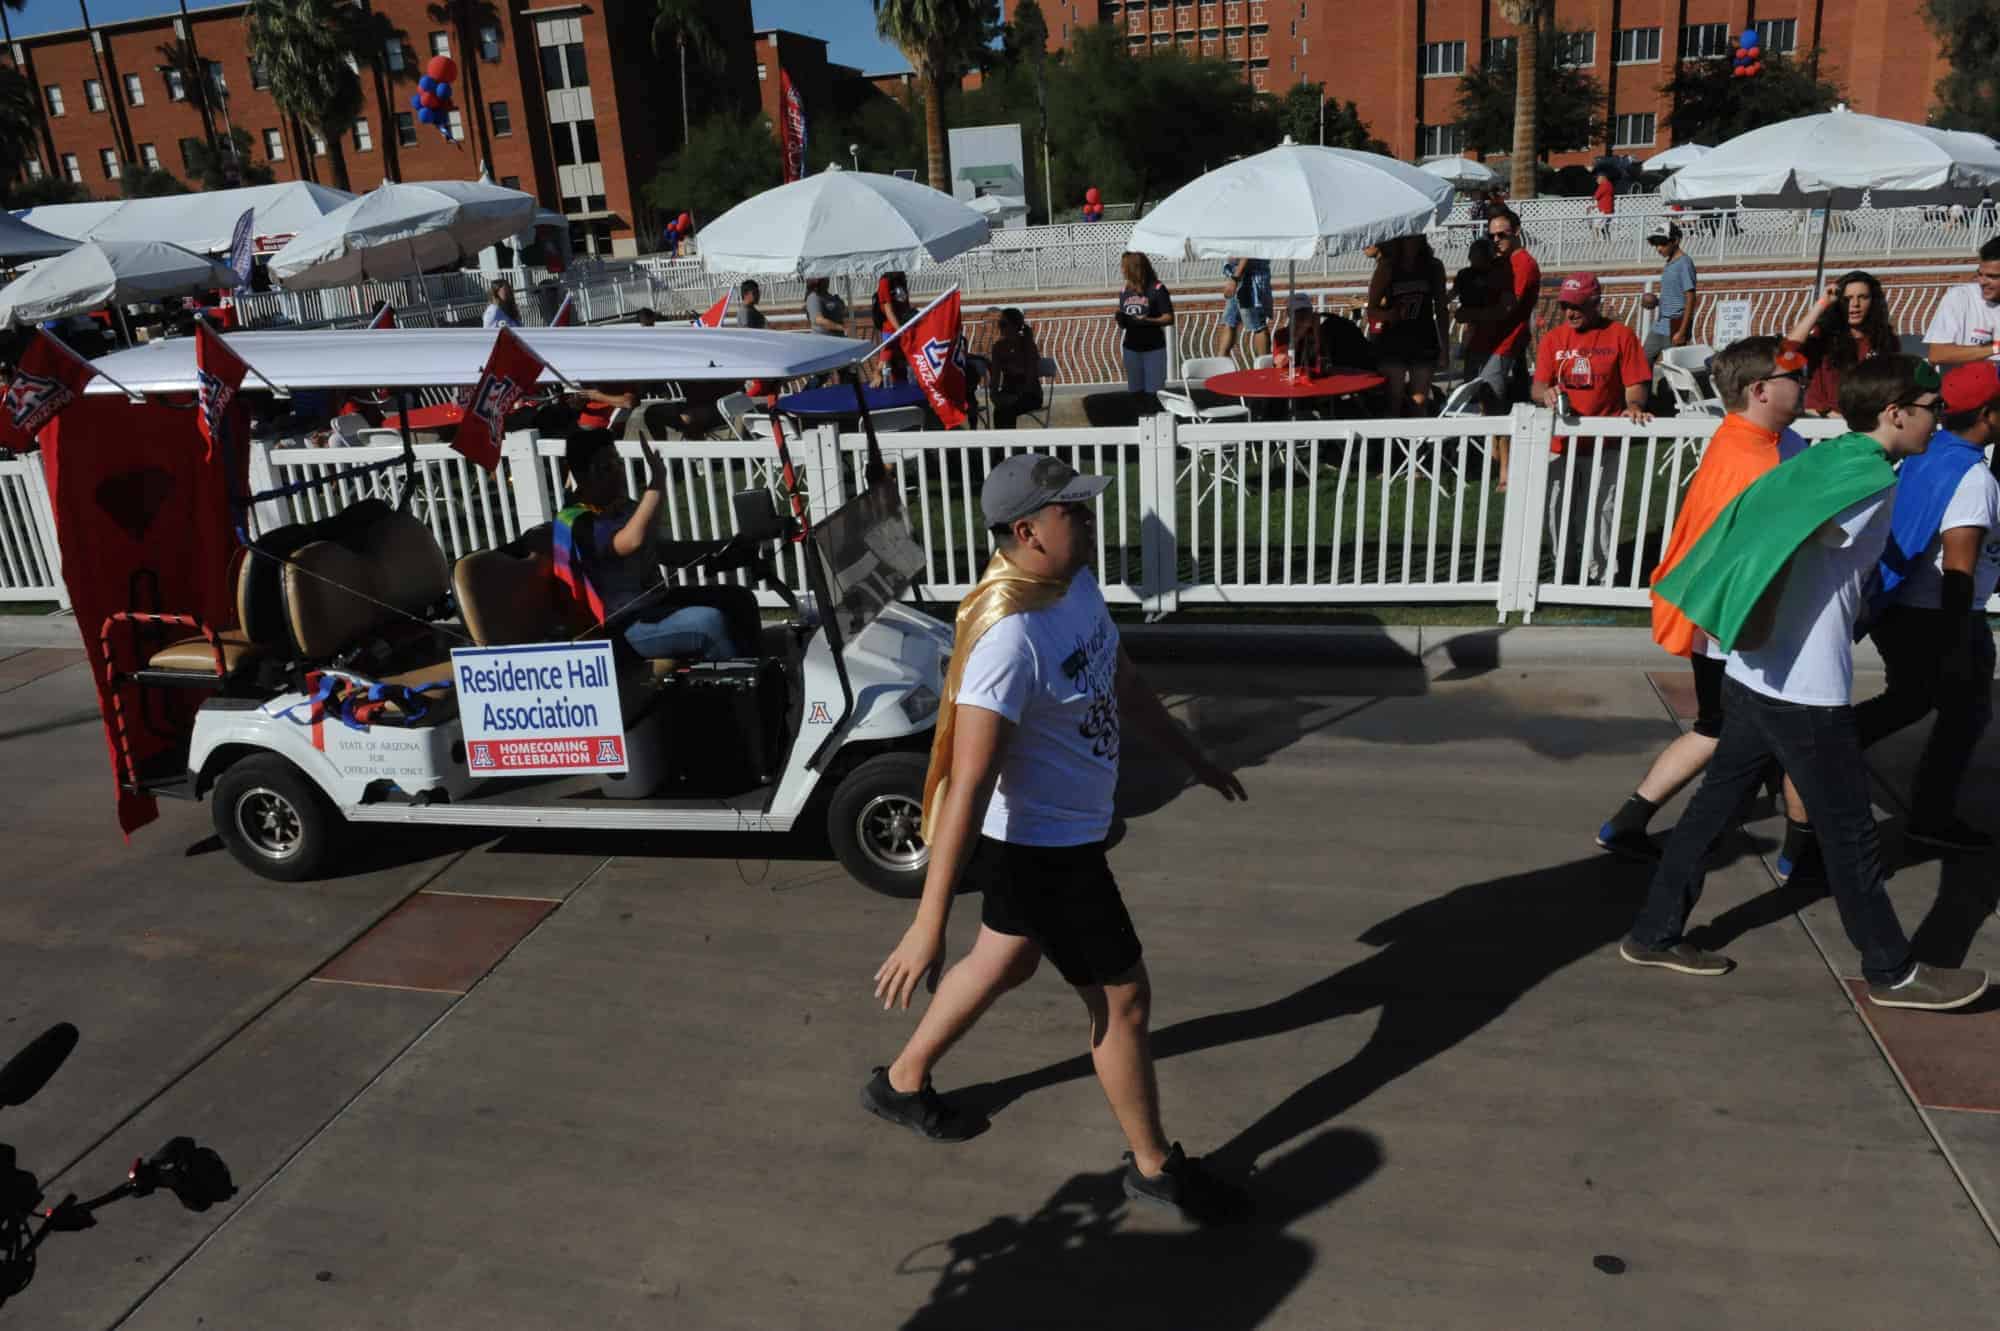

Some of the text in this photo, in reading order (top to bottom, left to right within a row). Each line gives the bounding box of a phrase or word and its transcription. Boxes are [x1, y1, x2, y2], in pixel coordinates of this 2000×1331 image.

[459, 655, 609, 694] Residence Hall
[482, 695, 598, 731] Association
[340, 741, 420, 751] STATE OF ARIZONA
[500, 740, 589, 754] HOMECOMING
[369, 754, 385, 762] FOR
[502, 751, 590, 766] CELEBRATION
[343, 766, 378, 775] OFFICIAL
[400, 767, 424, 776] ONLY
